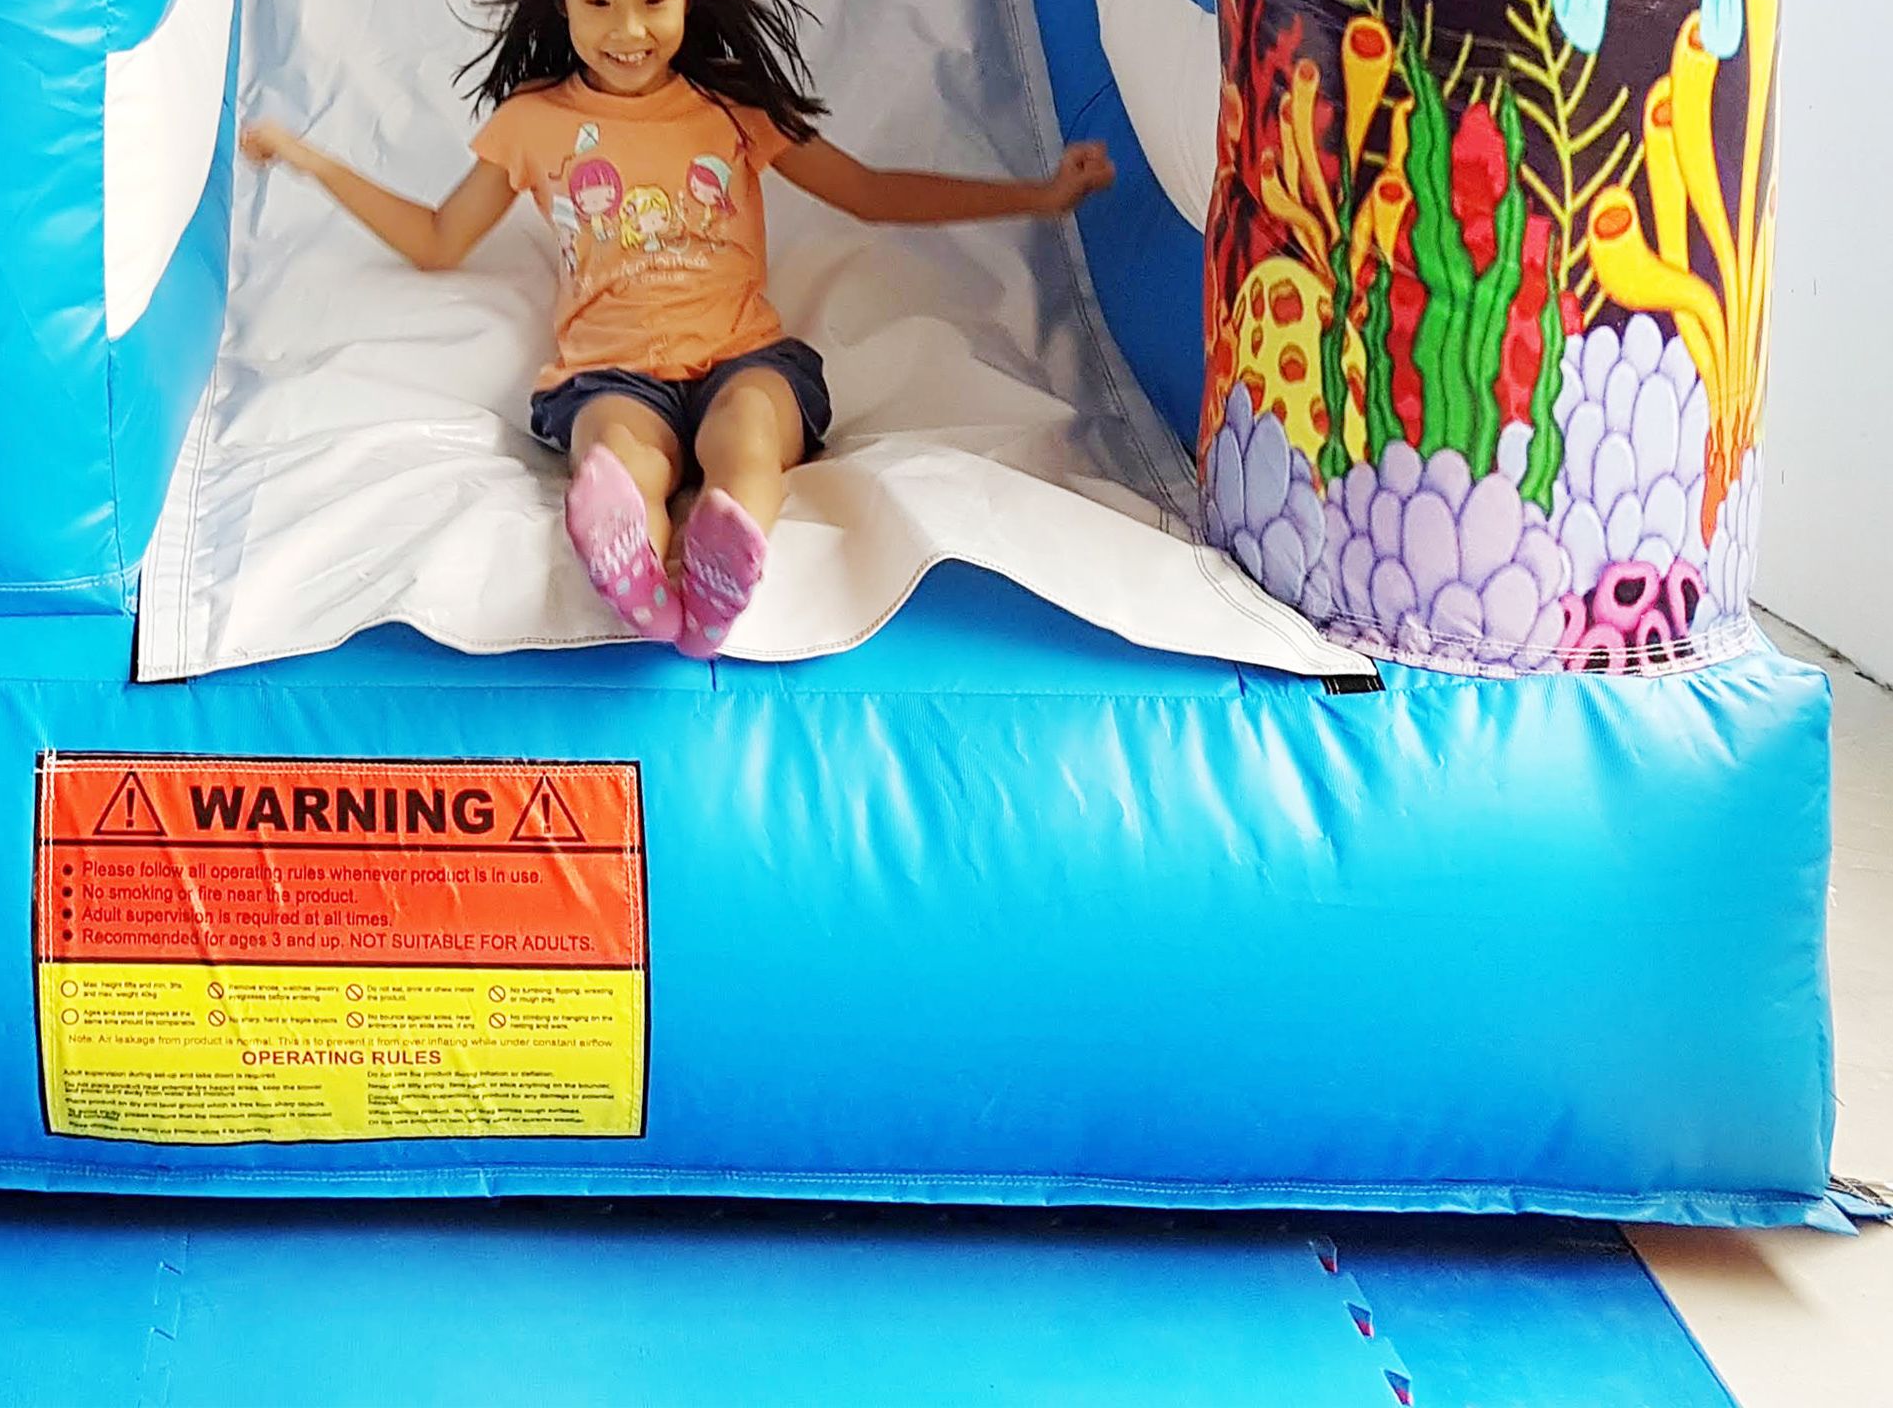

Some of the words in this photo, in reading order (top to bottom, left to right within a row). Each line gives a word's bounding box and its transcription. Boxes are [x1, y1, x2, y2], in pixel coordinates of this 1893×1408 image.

[189, 785, 495, 835] WARNING
[82, 862, 134, 877] Please
[140, 863, 184, 878] follow
[188, 864, 205, 878] all
[211, 864, 282, 882] operating
[288, 864, 324, 880] rules
[330, 866, 406, 880] whenever
[411, 868, 470, 884] product
[475, 868, 486, 882] is
[492, 868, 504, 882] in
[511, 872, 542, 883] use.
[83, 886, 104, 899] No
[109, 886, 172, 904] smoking
[178, 890, 192, 900] or
[199, 886, 222, 900] fire
[228, 890, 262, 902] near
[267, 888, 290, 902] the
[296, 888, 358, 905] product.
[82, 908, 121, 922] Adult
[126, 910, 213, 926] supervision
[219, 910, 230, 924] is
[236, 910, 299, 928] required
[306, 912, 320, 925] at
[324, 912, 341, 926] all
[346, 912, 392, 926] times.
[82, 928, 199, 944] Recommended
[204, 930, 224, 945] for
[230, 934, 266, 948] ages
[272, 932, 280, 946] 3
[286, 932, 314, 946] and
[322, 936, 344, 950] up.
[350, 934, 387, 948] NOT
[392, 934, 472, 949] SUITABLE
[480, 935, 516, 950] FOR
[523, 936, 594, 951] ADULTS.
[98, 1034, 111, 1043] Air
[114, 1035, 155, 1046] leakage
[158, 1035, 180, 1044] from
[184, 1036, 222, 1047] product
[278, 1036, 299, 1046] This
[302, 1038, 310, 1046] is
[313, 1037, 323, 1046] to
[326, 1037, 364, 1047] prevent
[368, 1038, 373, 1046] it
[376, 1037, 400, 1046] from
[402, 1038, 425, 1046] over
[428, 1037, 468, 1047] inflating
[470, 1037, 497, 1045] while
[500, 1038, 529, 1046] under
[532, 1038, 576, 1047] constant
[242, 1051, 364, 1065] OPERATING
[372, 1050, 442, 1065] RULES
